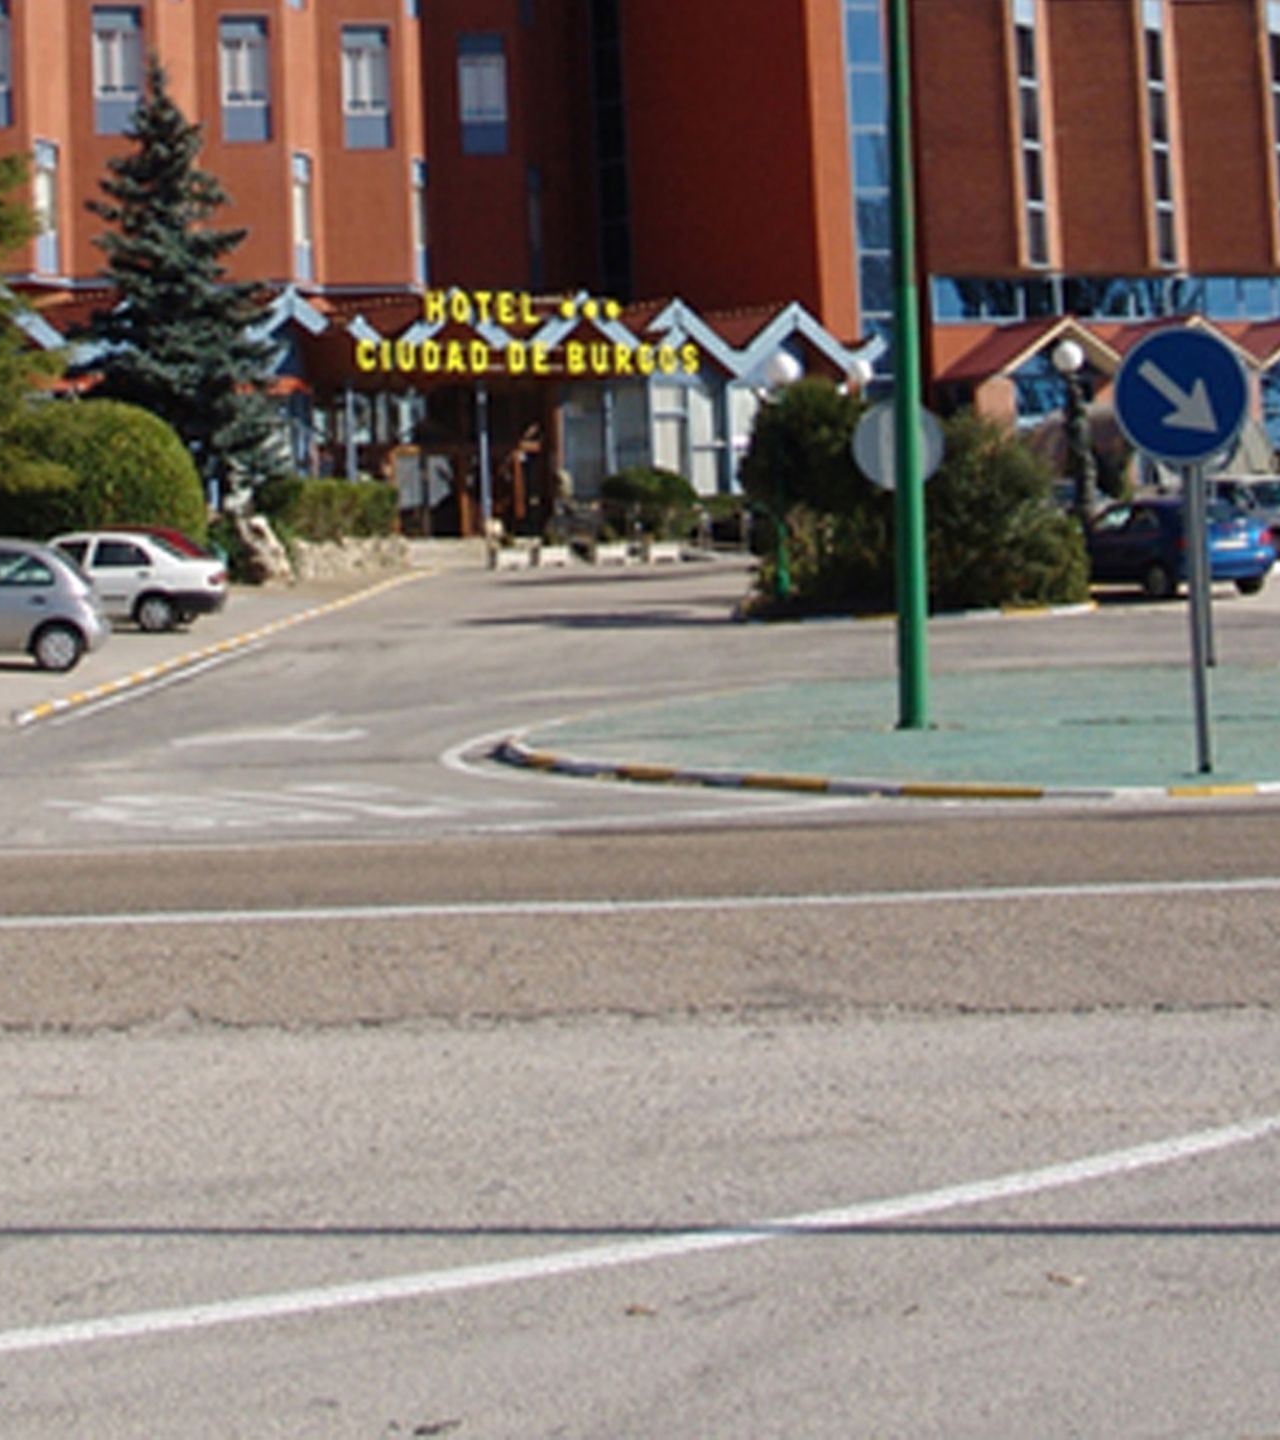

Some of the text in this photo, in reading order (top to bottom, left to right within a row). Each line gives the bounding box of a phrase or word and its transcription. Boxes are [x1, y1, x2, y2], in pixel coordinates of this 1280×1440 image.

[425, 290, 540, 324] HOTEL
[355, 339, 700, 375] CIUDAD DE BURGOS
